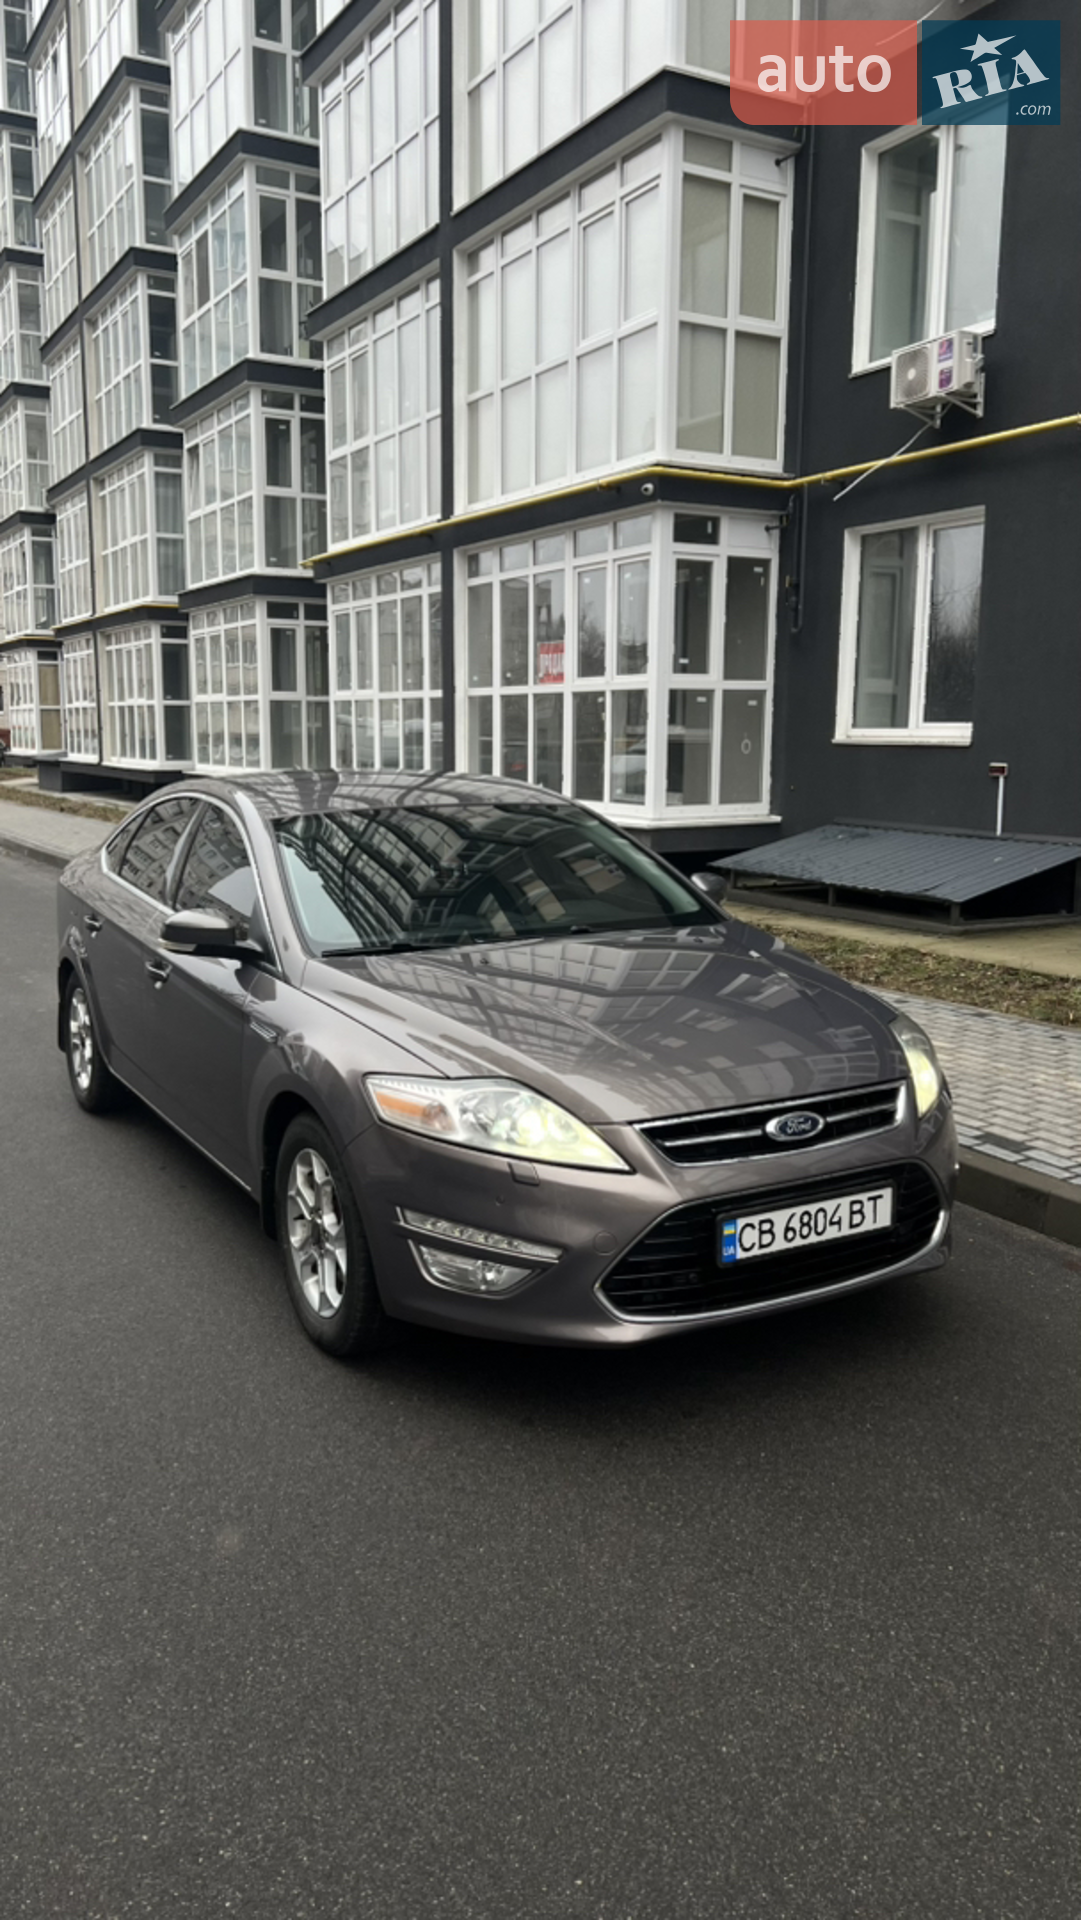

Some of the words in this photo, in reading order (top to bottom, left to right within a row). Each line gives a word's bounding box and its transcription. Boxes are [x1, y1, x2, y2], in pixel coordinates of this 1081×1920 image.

[786, 1117, 812, 1134] Ford
[738, 1218, 776, 1253] CB
[783, 1203, 842, 1243] 6804
[848, 1194, 884, 1230] BT
